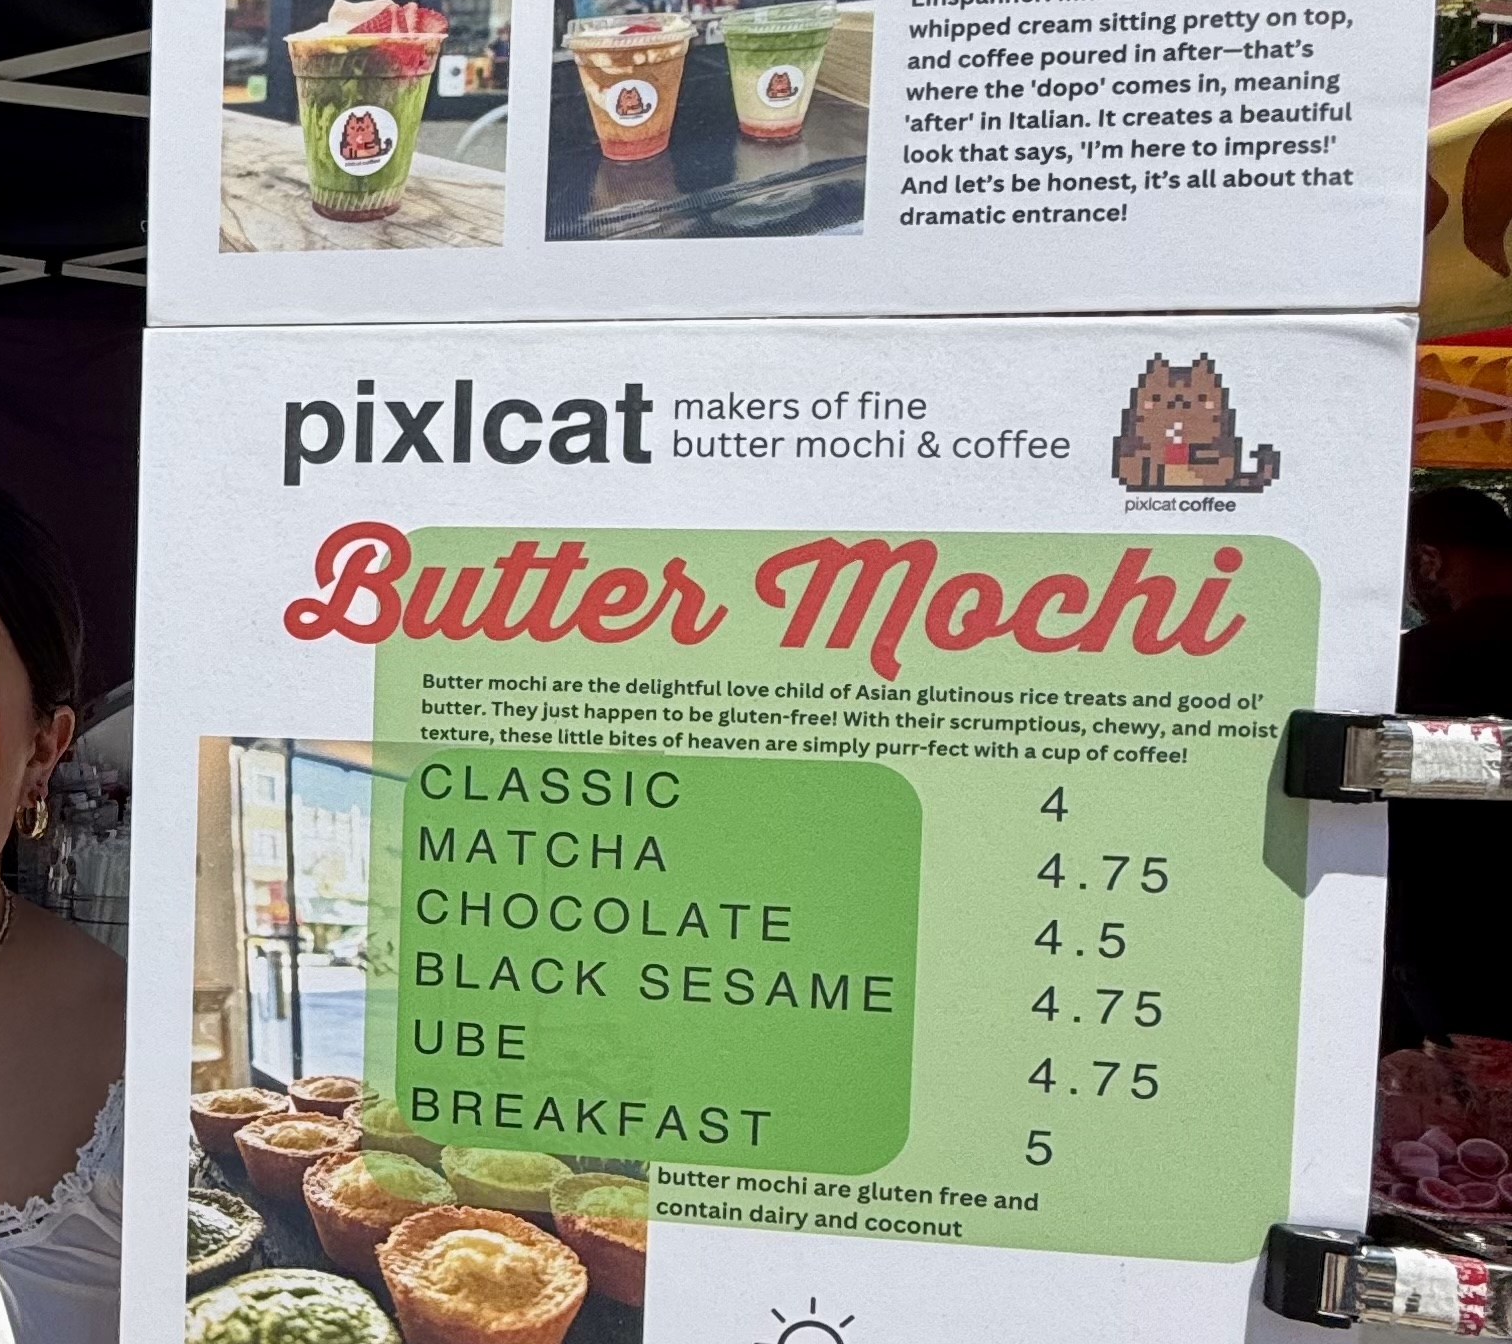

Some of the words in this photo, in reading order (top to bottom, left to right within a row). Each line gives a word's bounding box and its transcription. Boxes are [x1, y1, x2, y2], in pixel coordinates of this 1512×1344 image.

[906, 49, 952, 71] and
[957, 47, 1035, 69] coffee
[1039, 43, 1128, 72] poured
[1134, 42, 1157, 64] in
[899, 204, 1007, 227] dramatic
[1011, 202, 1128, 225] entrance!
[673, 391, 800, 421] makers
[810, 390, 850, 421] of
[857, 390, 927, 421] fine
[283, 379, 654, 487] pixlcat
[672, 428, 786, 459] butter
[795, 428, 906, 459] mochi
[916, 430, 942, 459] &
[951, 428, 1071, 460] coffee
[1178, 496, 1237, 513] coffee
[284, 522, 728, 644] Butter
[755, 538, 1246, 682] Mochi
[422, 672, 484, 691] Butter
[487, 674, 548, 692] mochi
[551, 679, 584, 693] are
[587, 676, 621, 695] the
[625, 677, 723, 700] delightful
[726, 680, 770, 699] love
[774, 681, 825, 700] child
[829, 682, 853, 700] of
[854, 683, 912, 702] Asian
[915, 684, 1015, 707] glutinous
[1019, 687, 1060, 706] rice
[1063, 690, 1128, 708] treats
[1131, 690, 1173, 709] and
[1176, 691, 1232, 714] good
[420, 763, 680, 809] CLASSIC
[1040, 785, 1069, 823] 4
[419, 826, 667, 872] MATCHA
[1036, 852, 1169, 894] 4.75
[416, 888, 791, 943] CHOCOLATE
[1034, 919, 1126, 959] 4.5
[415, 950, 608, 997] BLACK
[638, 962, 894, 1014] SESAME
[1031, 985, 1162, 1028] 4.75
[414, 1019, 526, 1061] UBE
[1027, 1057, 1159, 1100] 4.75
[411, 1086, 772, 1147] BREAKFAST
[1025, 1129, 1053, 1166] 5
[657, 1165, 731, 1190] butter
[736, 1175, 808, 1196] mochi
[812, 1182, 852, 1199] are
[856, 1181, 933, 1205] gluten
[938, 1185, 988, 1209] free
[993, 1192, 1039, 1212] and
[655, 1200, 743, 1222] contain
[748, 1204, 809, 1232] dairy
[813, 1210, 858, 1231] and
[864, 1216, 963, 1238] coconut
